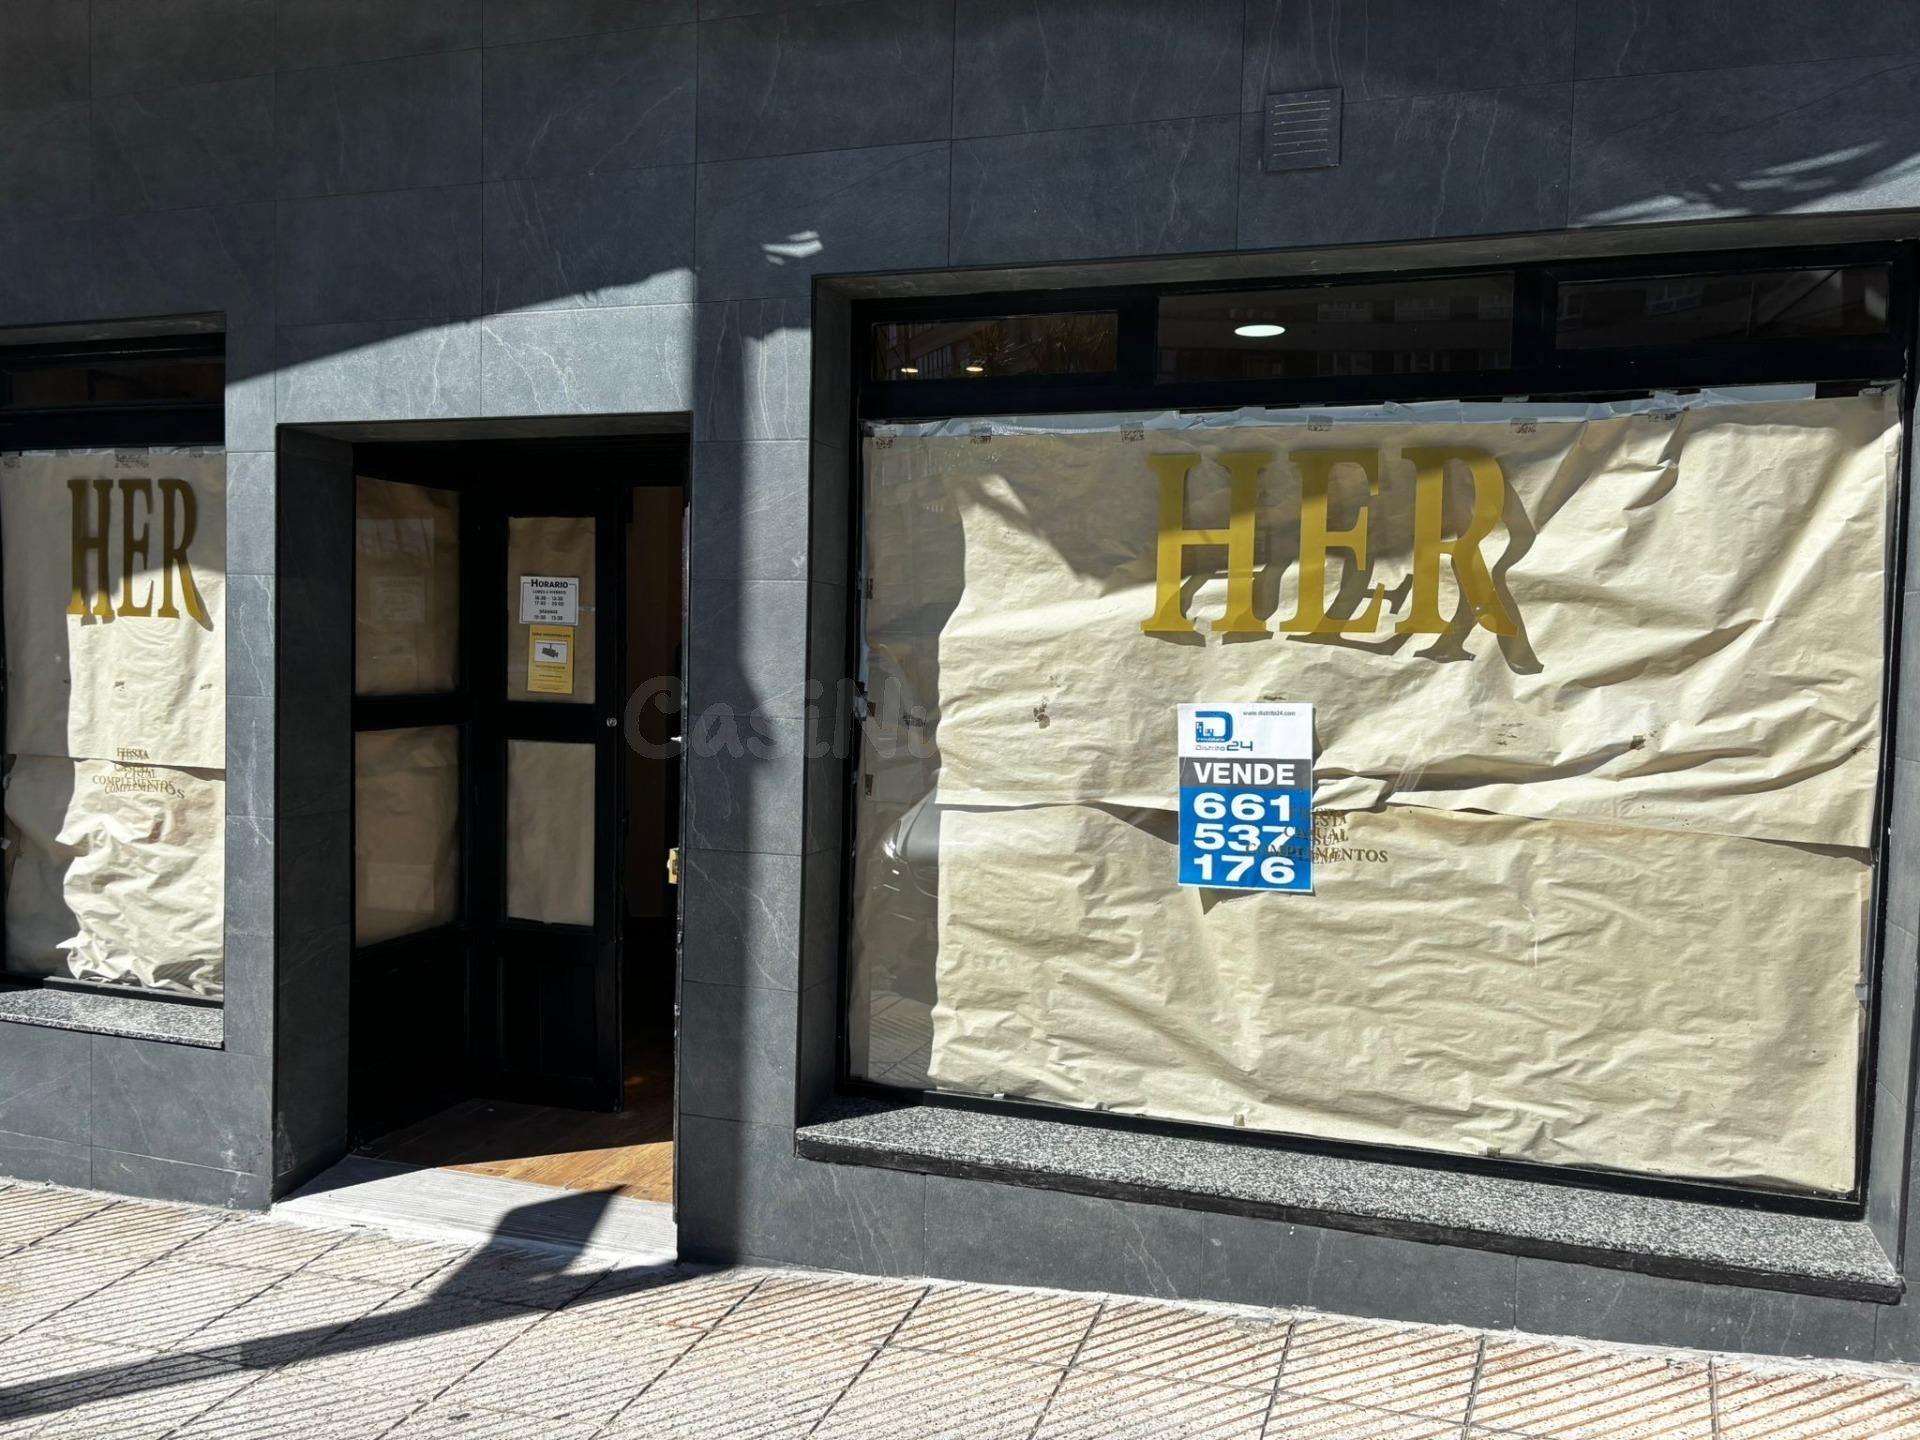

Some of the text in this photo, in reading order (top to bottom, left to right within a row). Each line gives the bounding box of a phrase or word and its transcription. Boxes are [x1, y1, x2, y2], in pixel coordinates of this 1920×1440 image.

[66, 478, 204, 622] HER
[1141, 447, 1519, 637] HER
[531, 579, 569, 588] HORARIO
[1193, 762, 1296, 785] VENDE
[1193, 792, 1291, 822] 661
[1193, 823, 1296, 852] 537
[1193, 855, 1296, 884] 176
